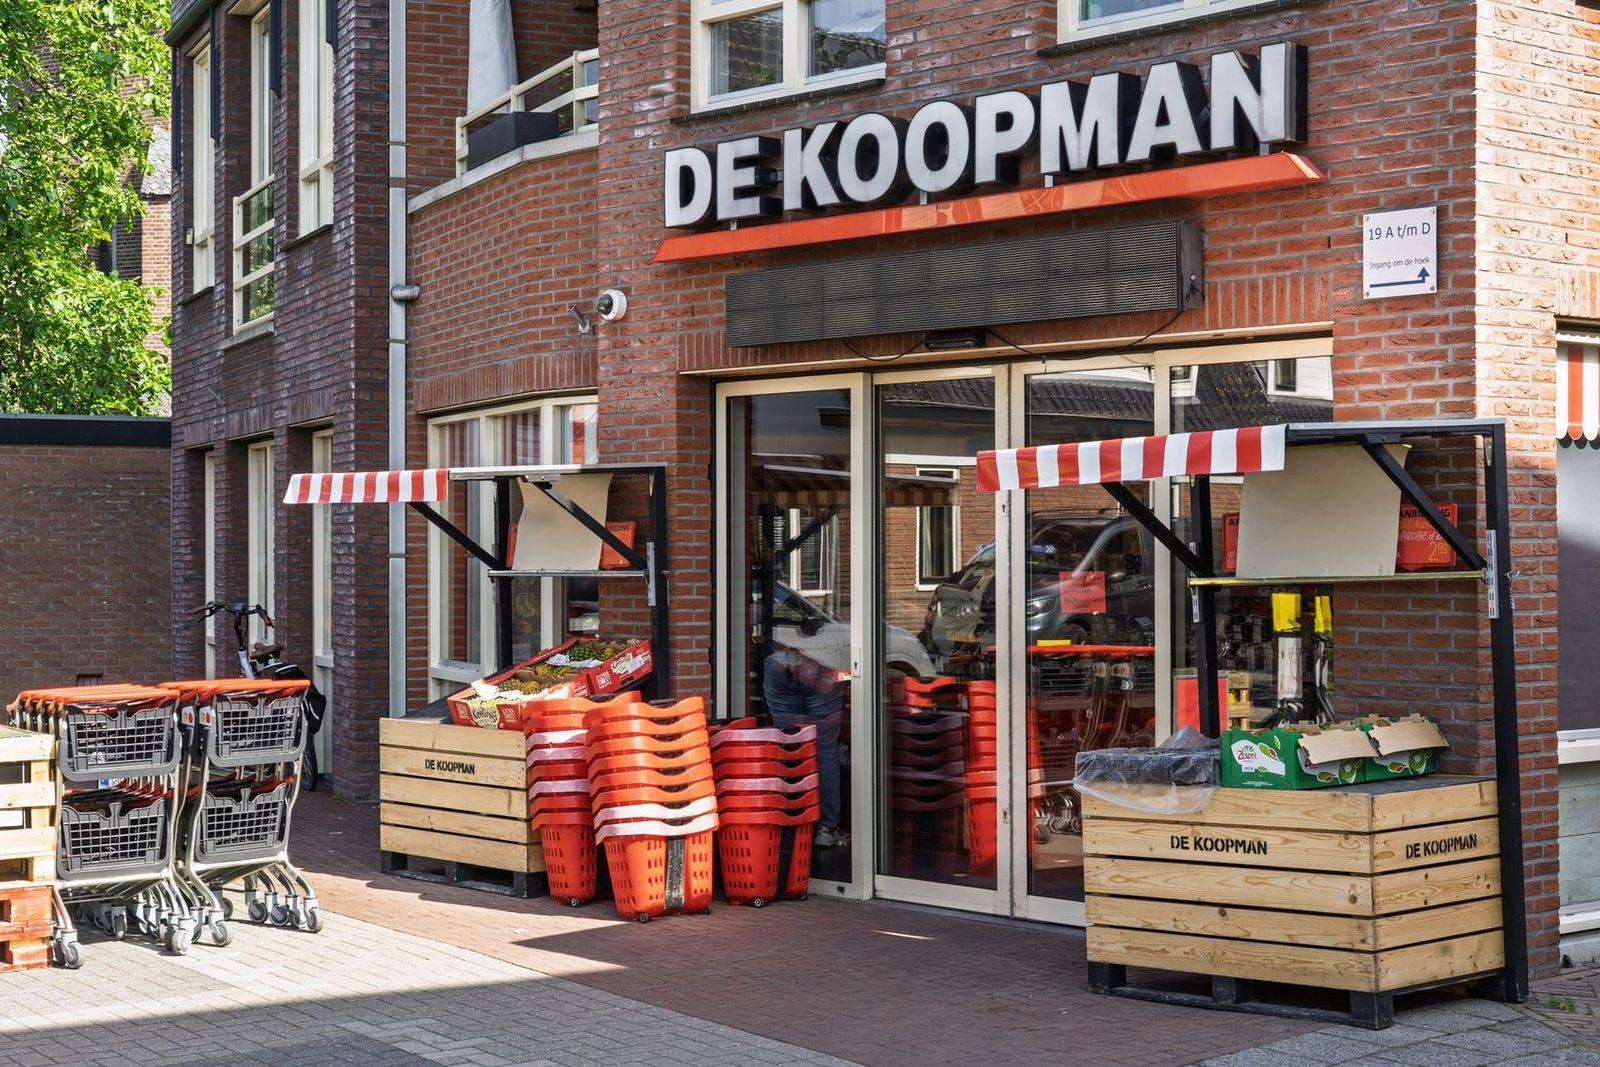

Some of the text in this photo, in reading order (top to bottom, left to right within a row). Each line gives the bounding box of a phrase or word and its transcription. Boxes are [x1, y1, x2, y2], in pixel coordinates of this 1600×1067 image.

[664, 41, 1294, 228] DE KOOPMAN
[1369, 222, 1431, 240] 19 A t/m D
[1369, 260, 1392, 270] Ingang
[1404, 257, 1413, 266] de
[1414, 256, 1430, 265] hoek
[425, 758, 475, 775] DE KOOPMAN
[1170, 835, 1267, 855] DE KOOPMAN
[1405, 833, 1477, 859] DE KOOPMAN
